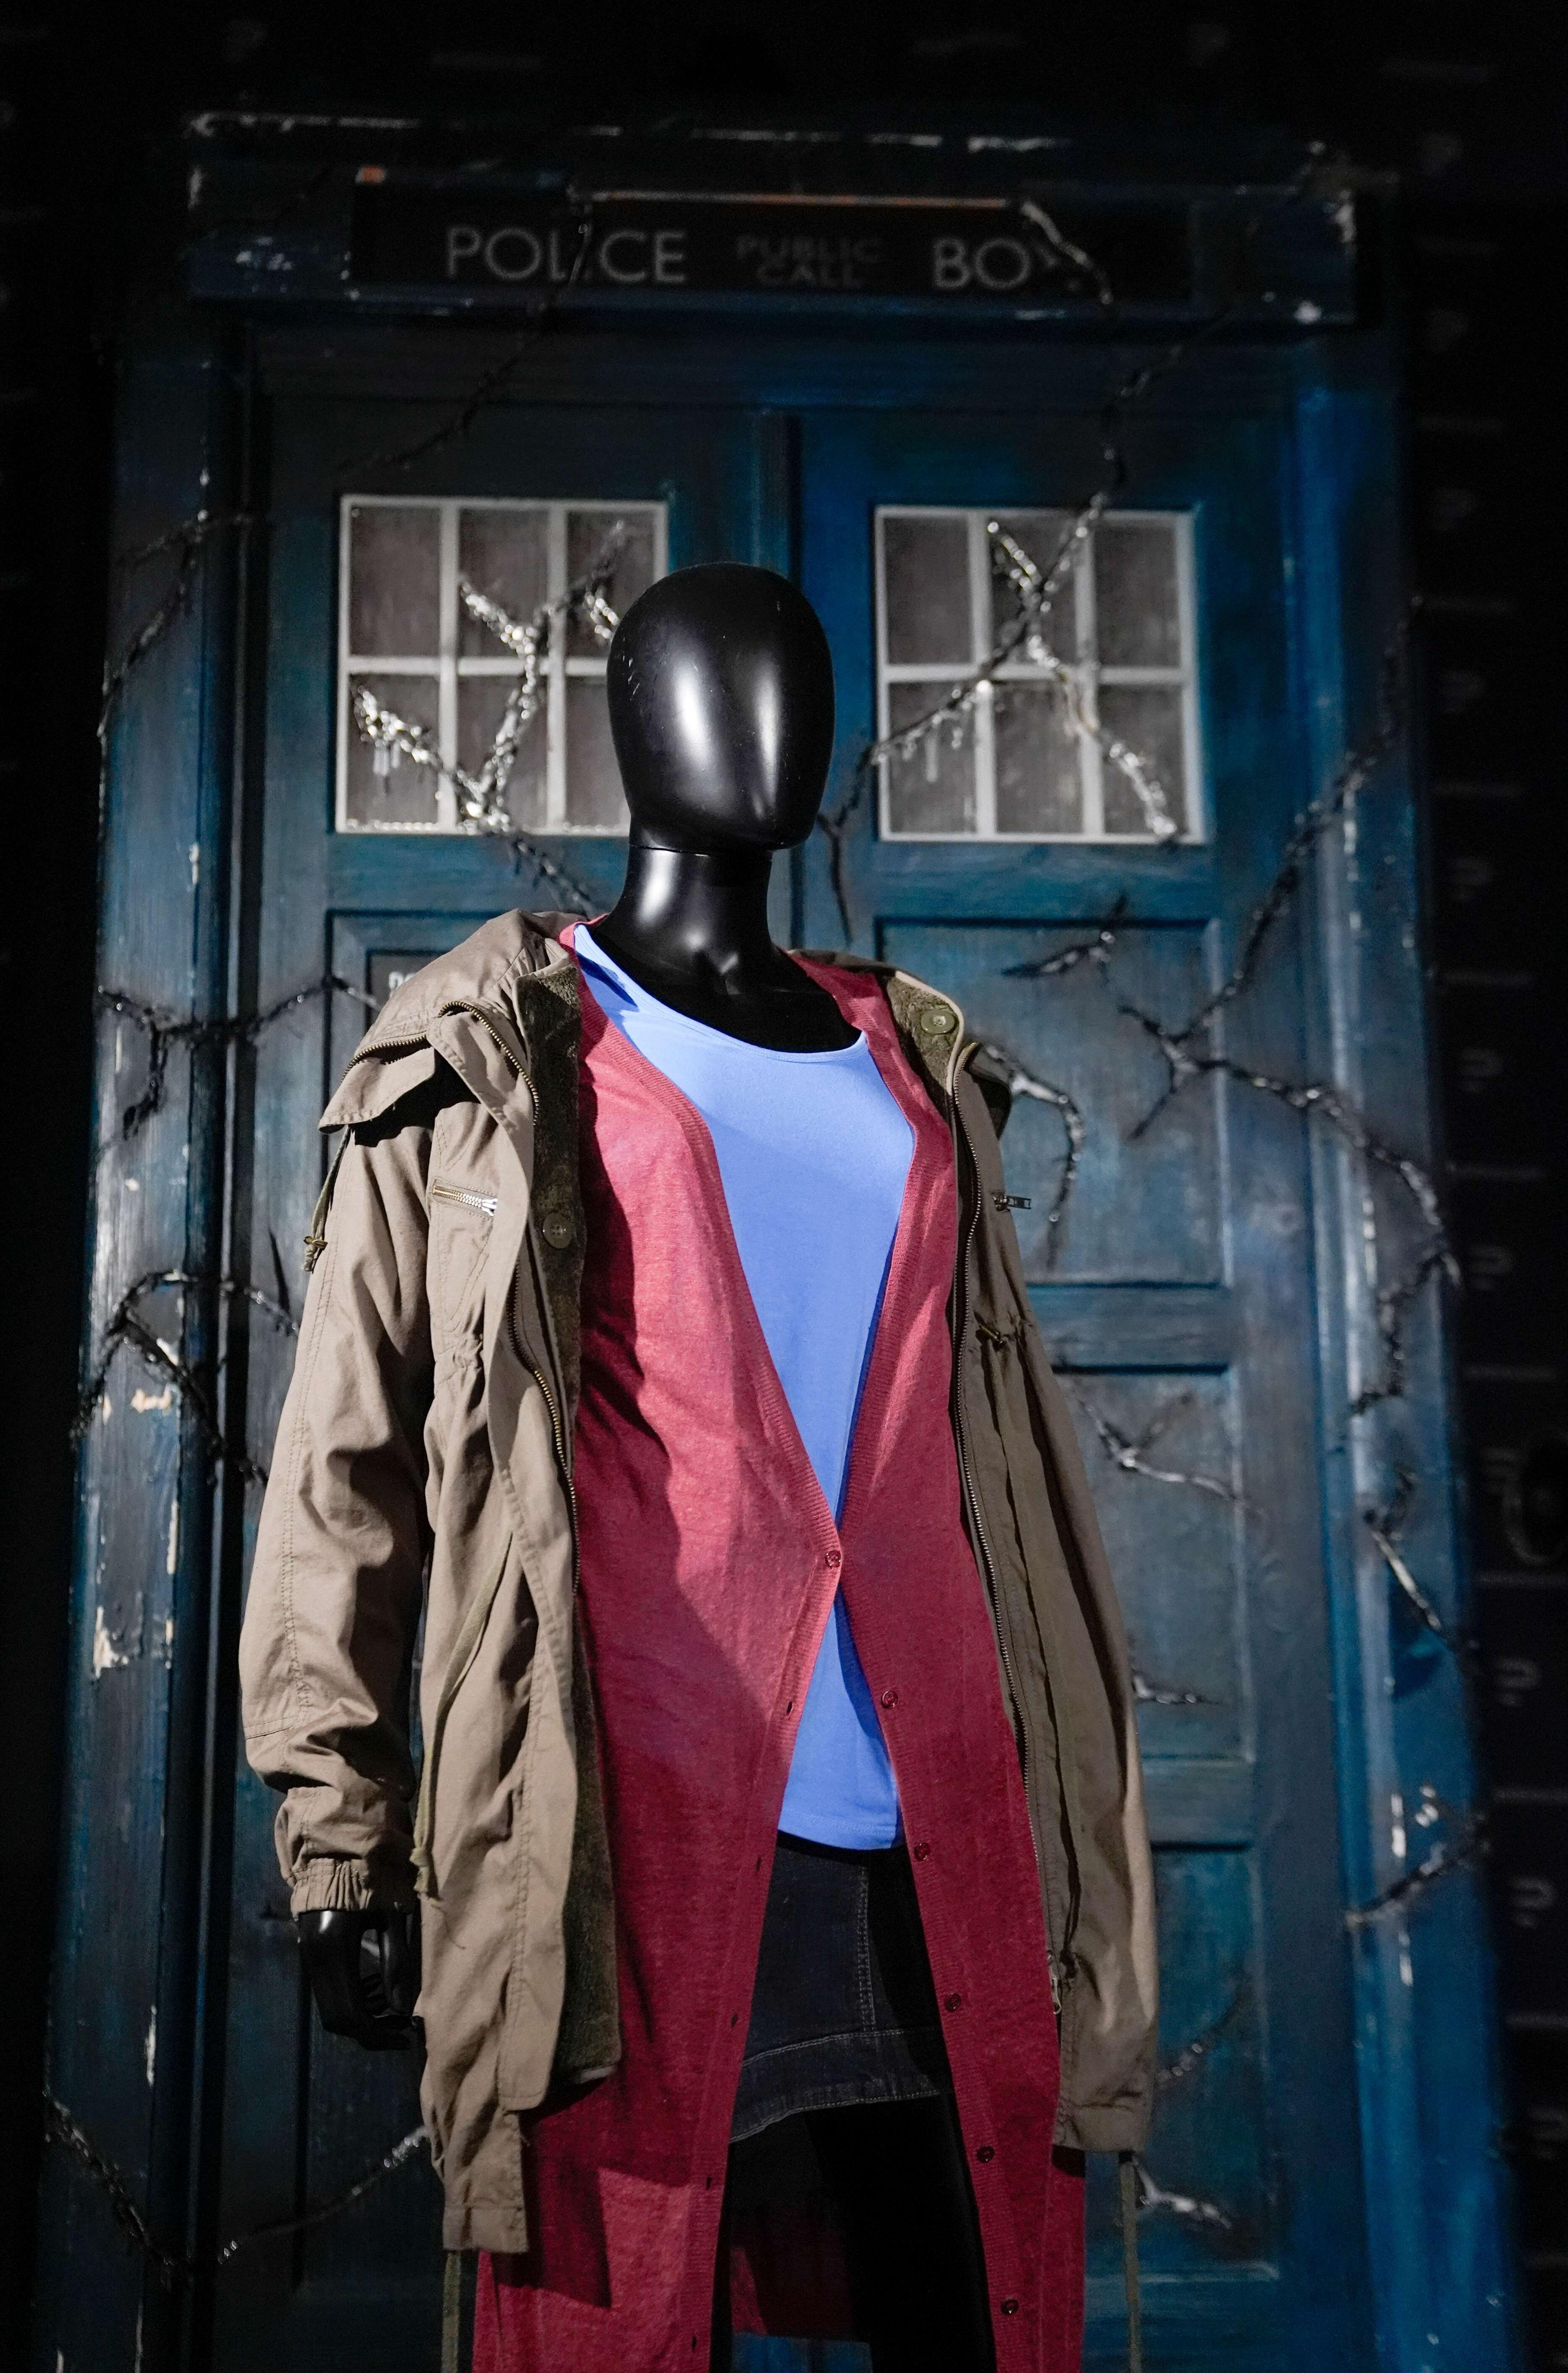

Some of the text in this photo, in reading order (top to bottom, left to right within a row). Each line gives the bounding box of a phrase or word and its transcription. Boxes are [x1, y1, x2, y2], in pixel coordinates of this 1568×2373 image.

[447, 225, 687, 283] POLCE
[736, 234, 882, 264] PUBLIC
[755, 262, 864, 287] CALL
